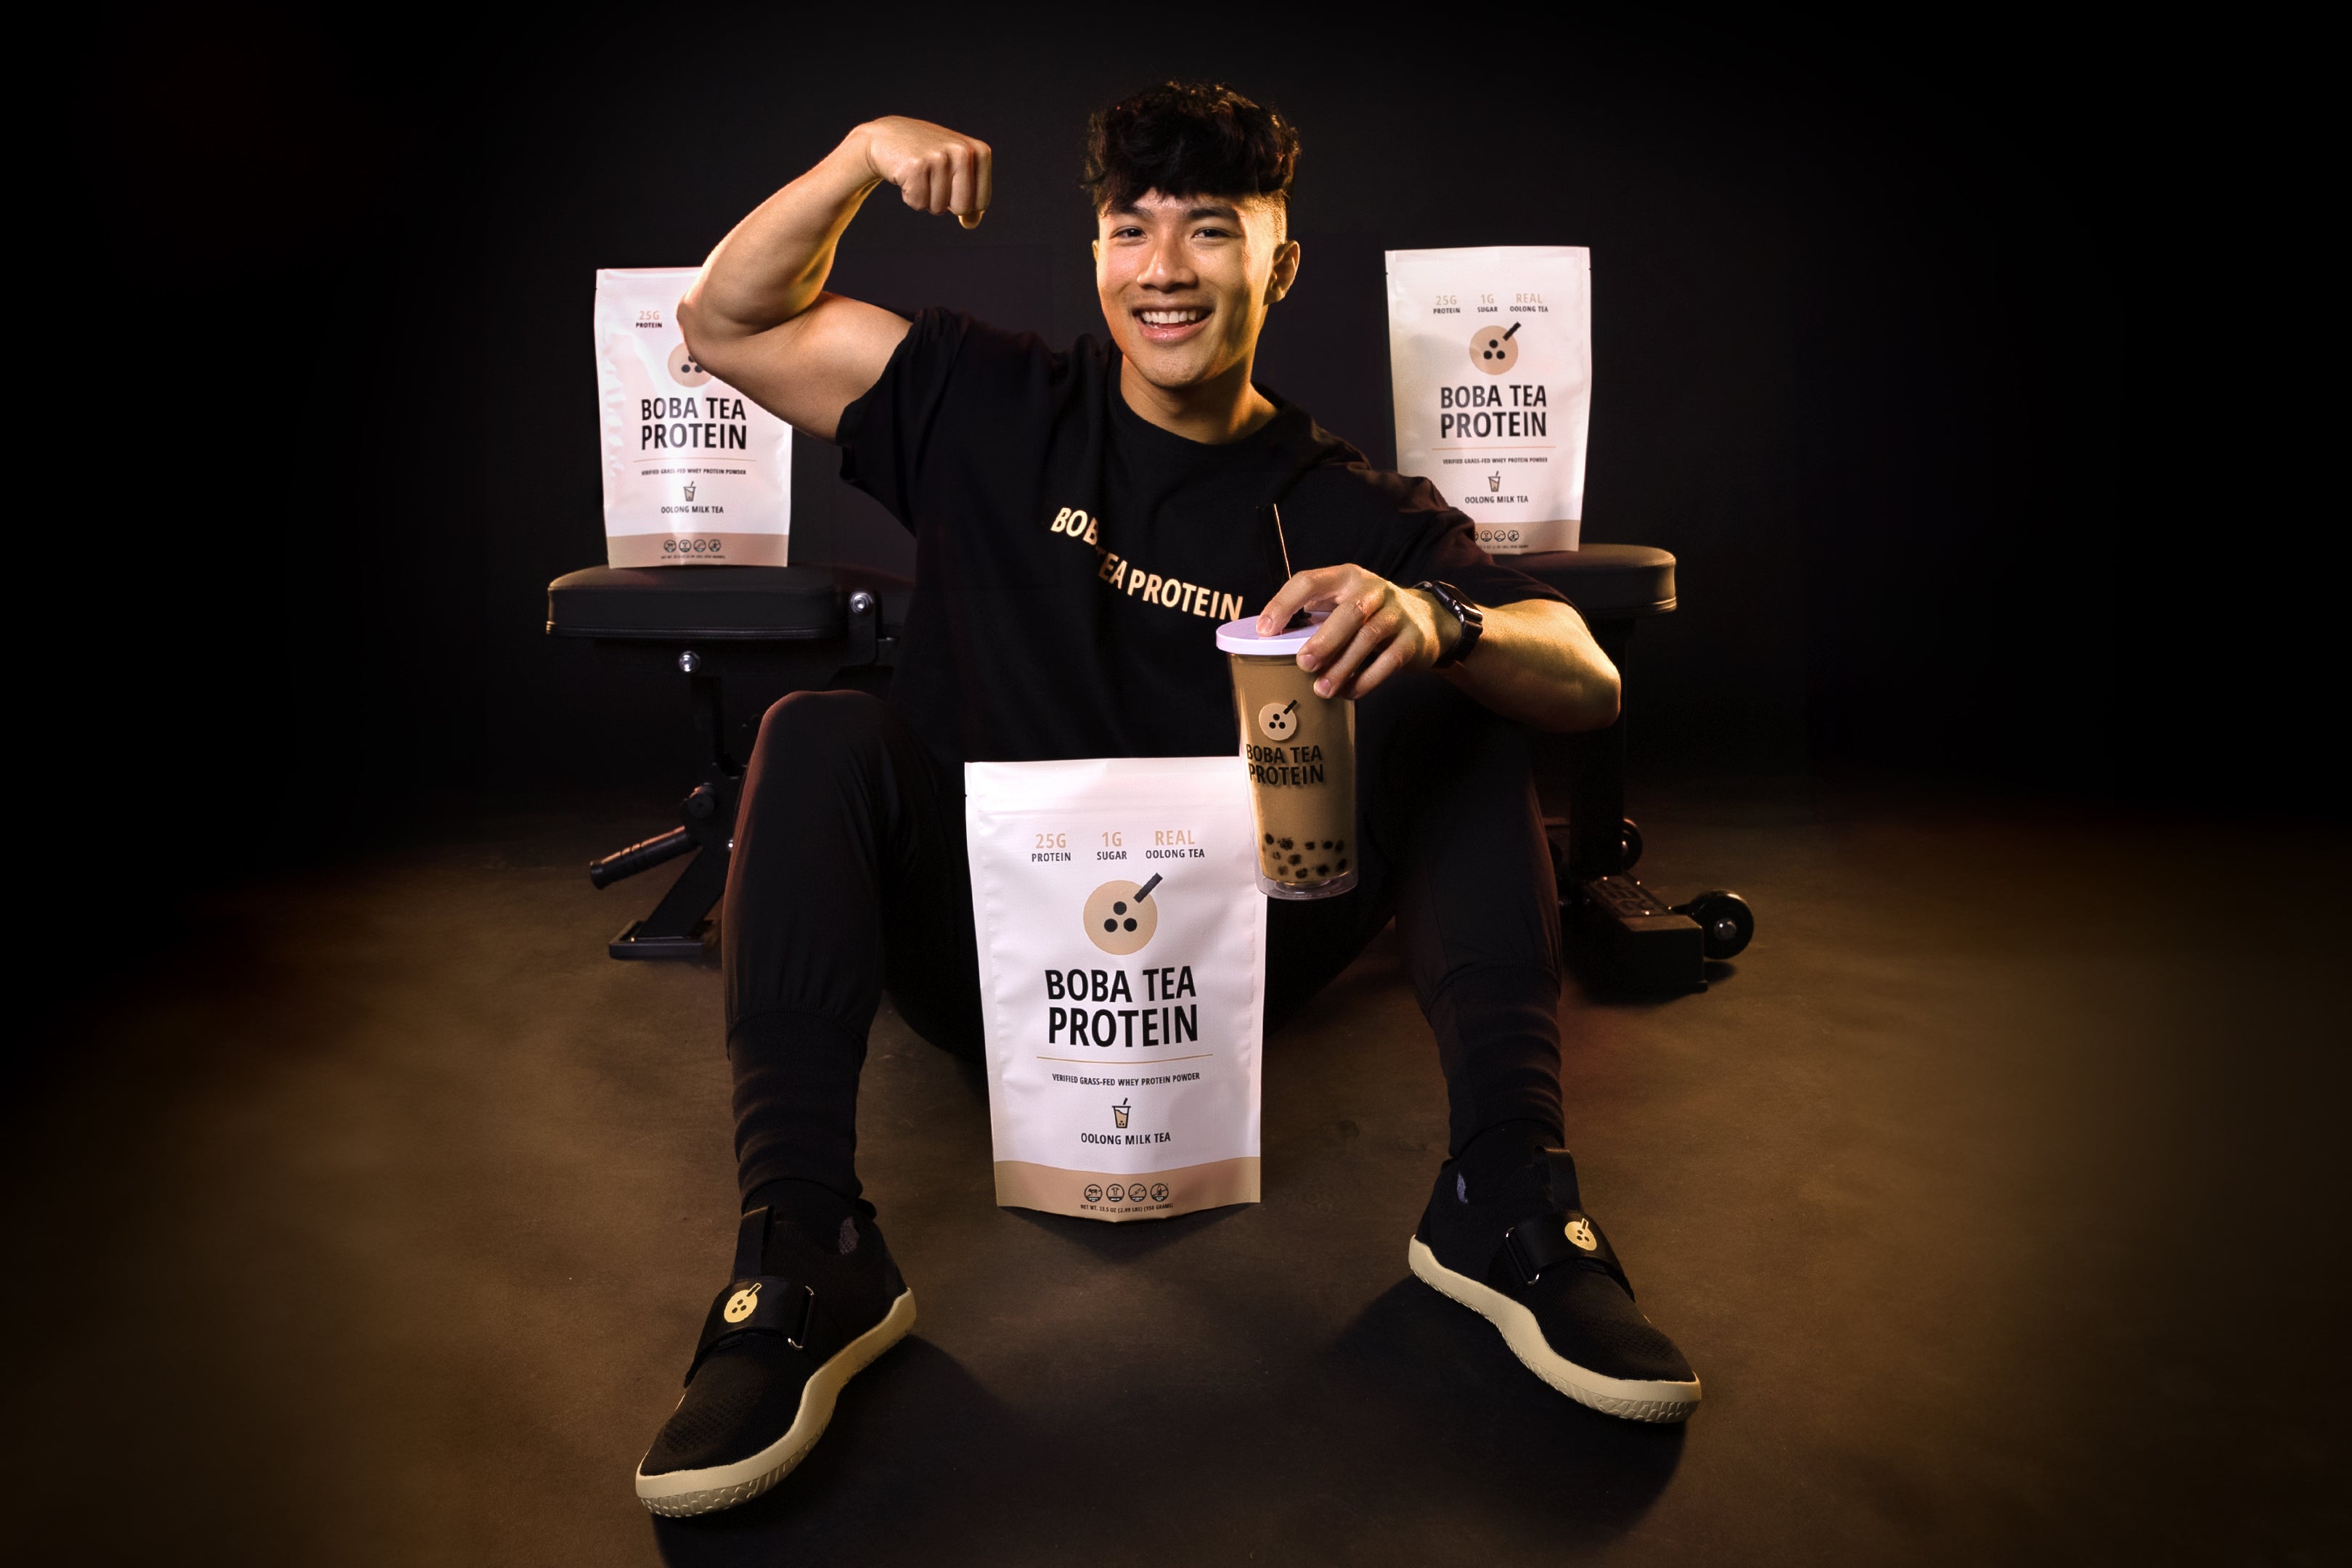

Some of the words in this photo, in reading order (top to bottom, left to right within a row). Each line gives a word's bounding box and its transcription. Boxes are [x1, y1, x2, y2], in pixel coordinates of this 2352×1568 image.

[1436, 295, 1457, 306] 25G
[1481, 294, 1494, 304] 1G
[1516, 293, 1543, 303] REAL
[639, 311, 660, 320] 25G
[1441, 385, 1503, 409] BOBA
[1510, 385, 1546, 407] TEA
[641, 398, 698, 420] BOBA
[706, 397, 746, 420] TEA
[1441, 412, 1546, 438] PROTEIN
[641, 423, 747, 450] PROTEIN
[1050, 507, 1099, 546] BOB
[1127, 569, 1243, 621] PROTEIN
[1246, 743, 1285, 764] BOBA
[1290, 745, 1322, 762] TEA
[1249, 763, 1324, 785] PROTEIN
[1035, 833, 1067, 849] 25G
[1101, 832, 1122, 847] 1G
[1154, 830, 1196, 846] REAL
[1032, 852, 1071, 862] PROTEIN
[1097, 851, 1127, 861] SUGAR
[1146, 849, 1185, 859] OOLONG
[1188, 848, 1205, 859] TEA
[1045, 968, 1132, 1003] BOBA
[1143, 966, 1196, 1002] TEA
[1048, 1004, 1199, 1048] PROTEIN
[1052, 1073, 1078, 1083] VERIFIED
[1079, 1077, 1115, 1086] GRASS-FED
[1141, 1077, 1170, 1086] PROTEIN
[1172, 1072, 1200, 1082] POWDER
[1081, 1133, 1121, 1145] OOLONG
[1125, 1134, 1151, 1145] MILK
[1154, 1132, 1171, 1143] TEA
